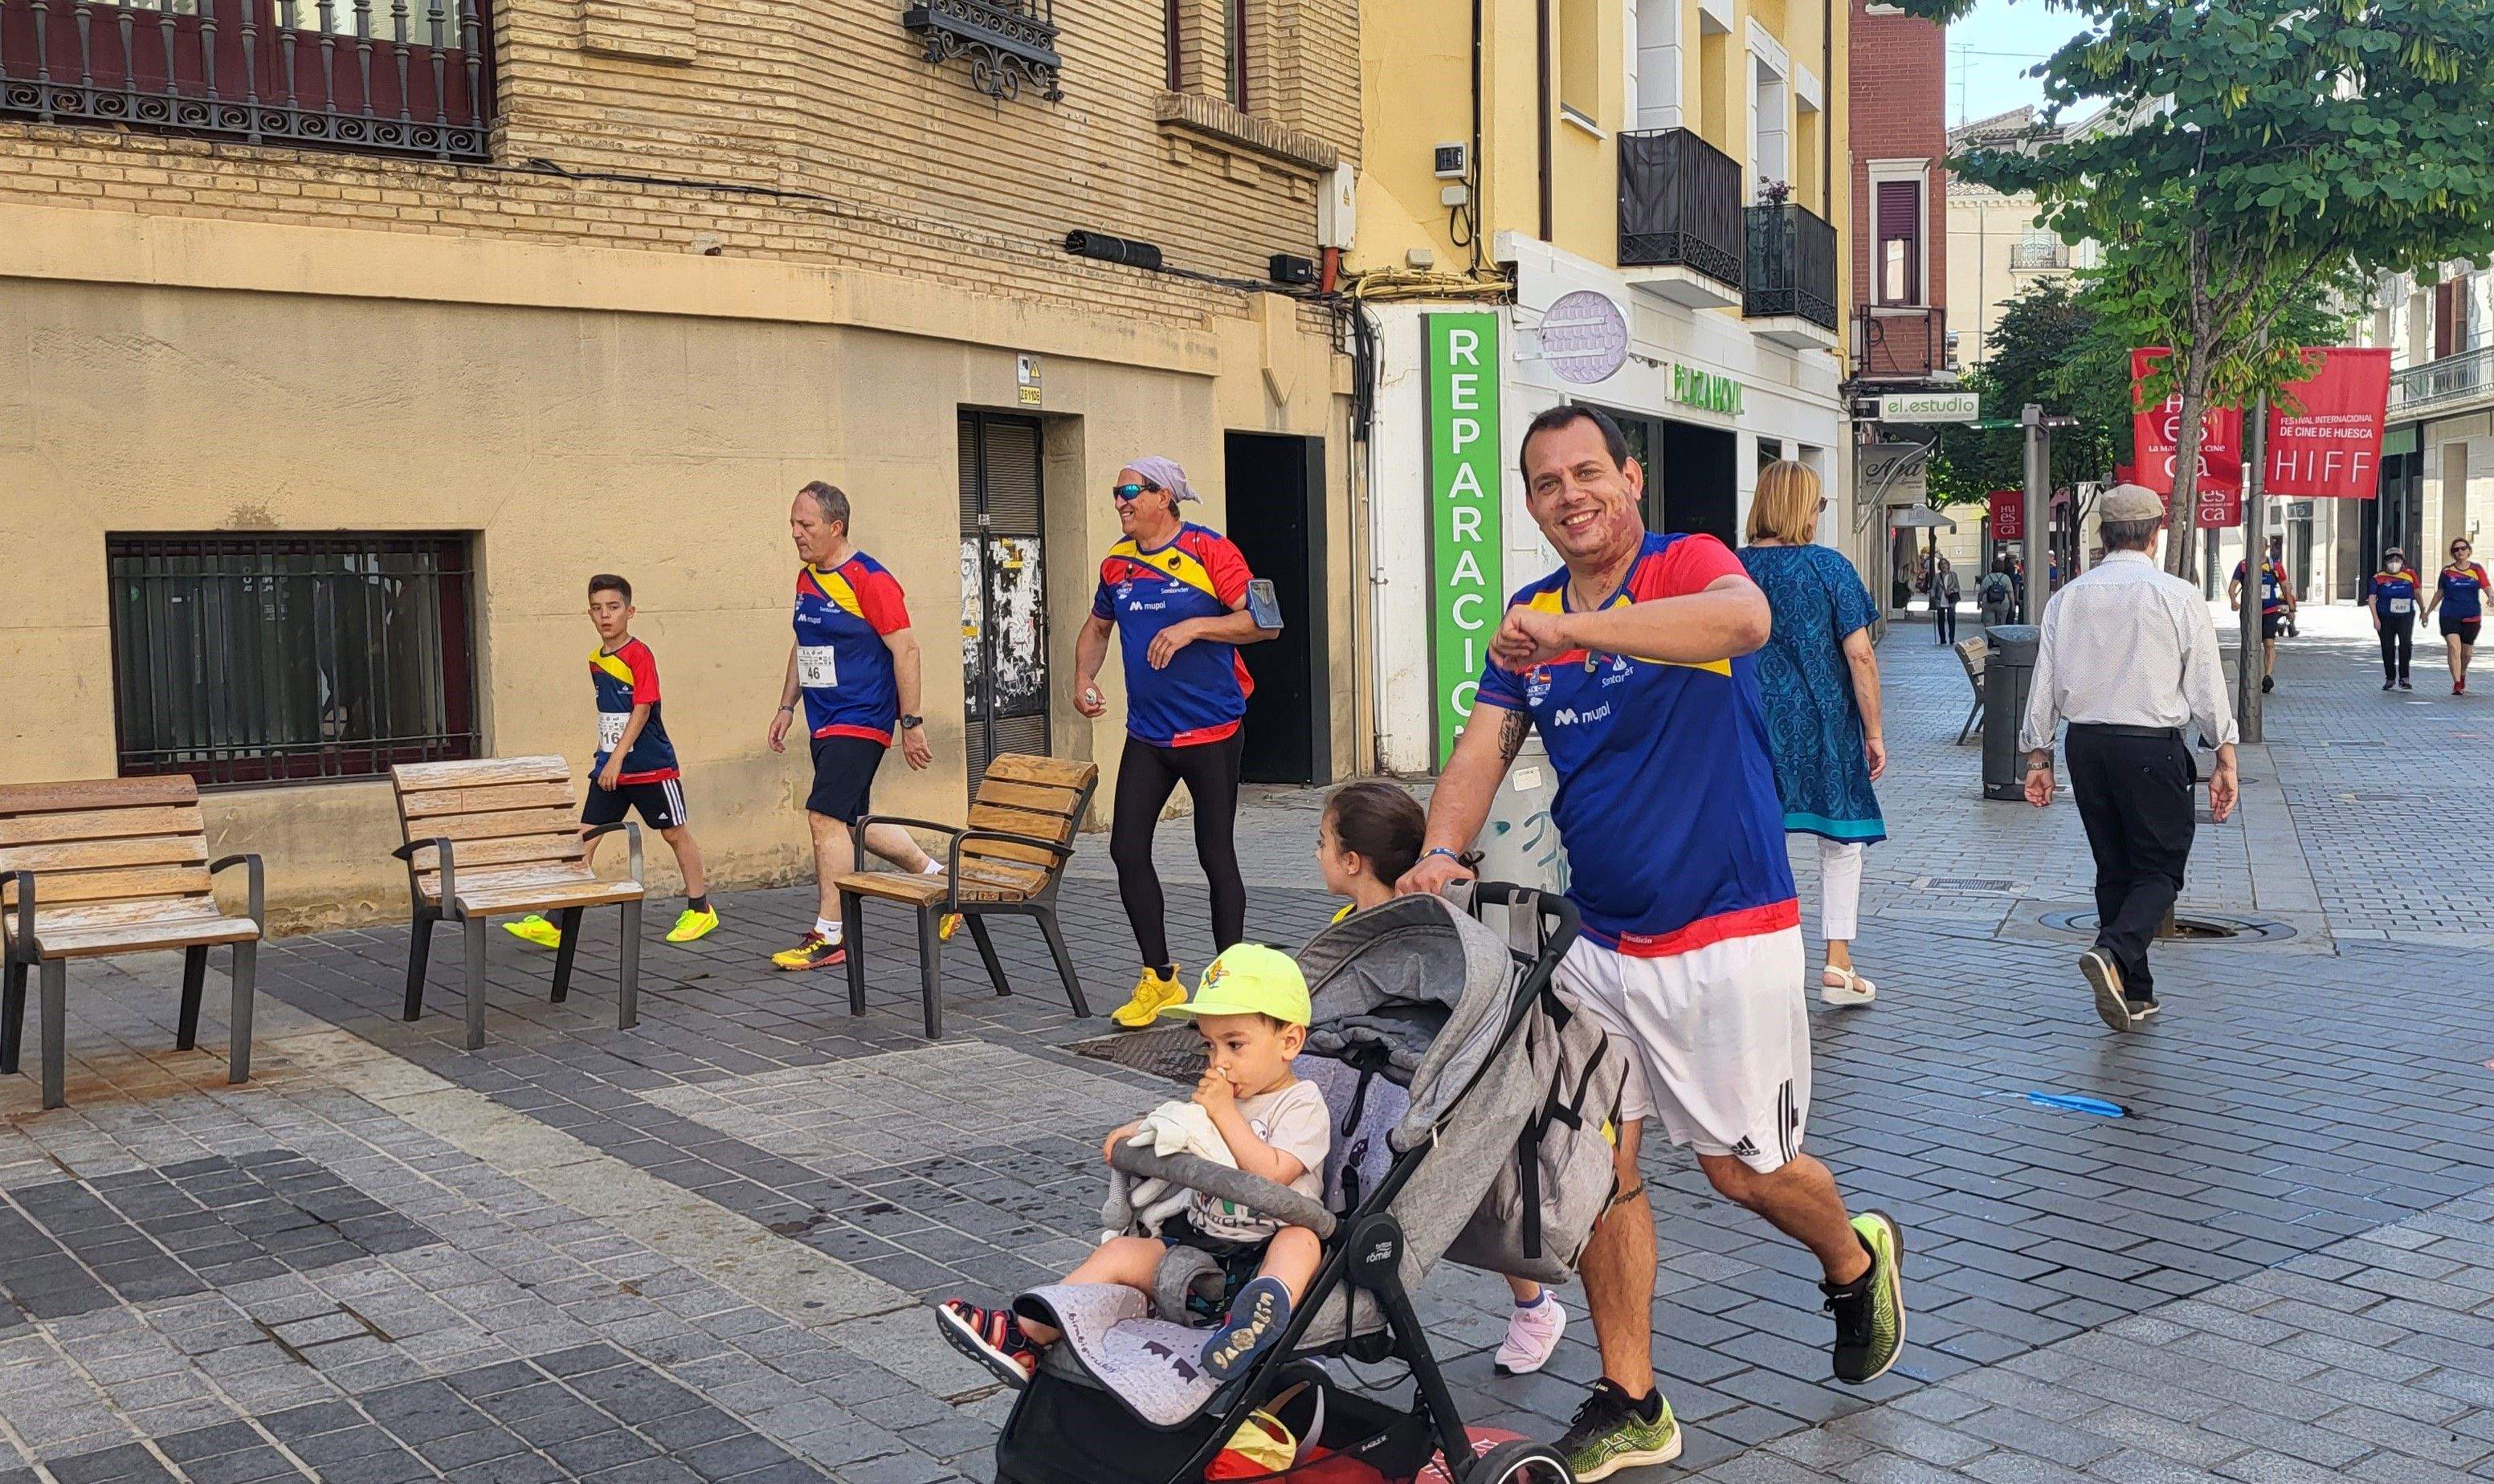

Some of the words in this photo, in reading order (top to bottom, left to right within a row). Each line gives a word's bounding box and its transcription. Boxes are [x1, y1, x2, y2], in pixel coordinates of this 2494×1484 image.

[2281, 417, 2313, 426] FESTIVAL
[2316, 414, 2374, 424] INTERNACIONAL
[2280, 426, 2292, 437] DE
[2295, 427, 2317, 438] CINE
[2319, 427, 2332, 438] DE
[2334, 428, 2373, 438] HUESCA
[2276, 450, 2372, 483] HIFF
[2000, 512, 2016, 523] es
[2000, 525, 2015, 535] ca
[808, 667, 820, 679] 46
[1582, 700, 1611, 723] mupol
